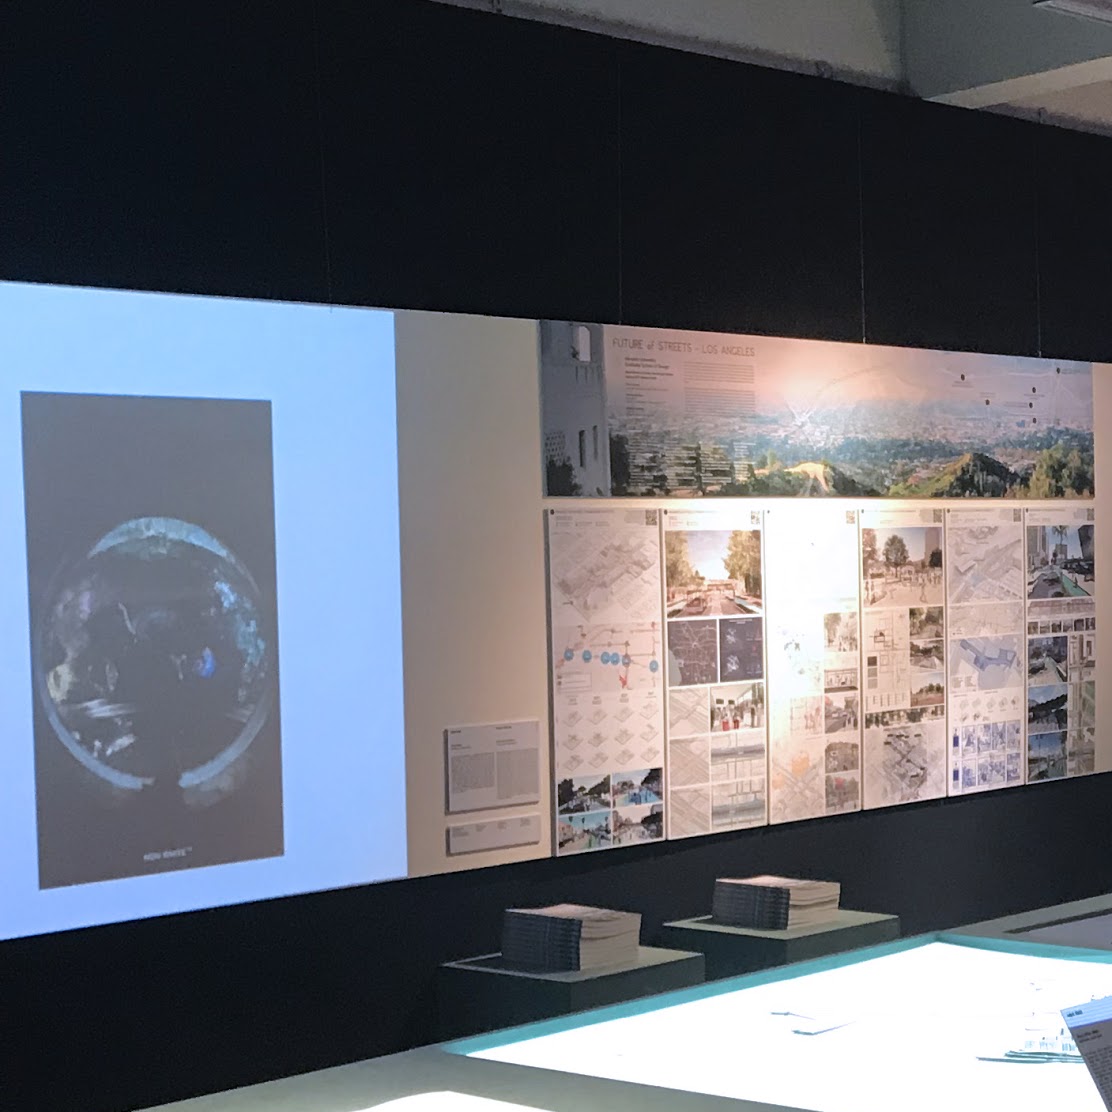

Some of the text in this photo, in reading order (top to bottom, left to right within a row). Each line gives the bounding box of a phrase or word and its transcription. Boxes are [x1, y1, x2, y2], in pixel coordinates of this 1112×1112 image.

[612, 338, 643, 350] FUTURE
[647, 341, 655, 350] of
[658, 341, 692, 353] STREETS
[701, 344, 718, 355] LOS
[721, 345, 755, 357] ANGELES
